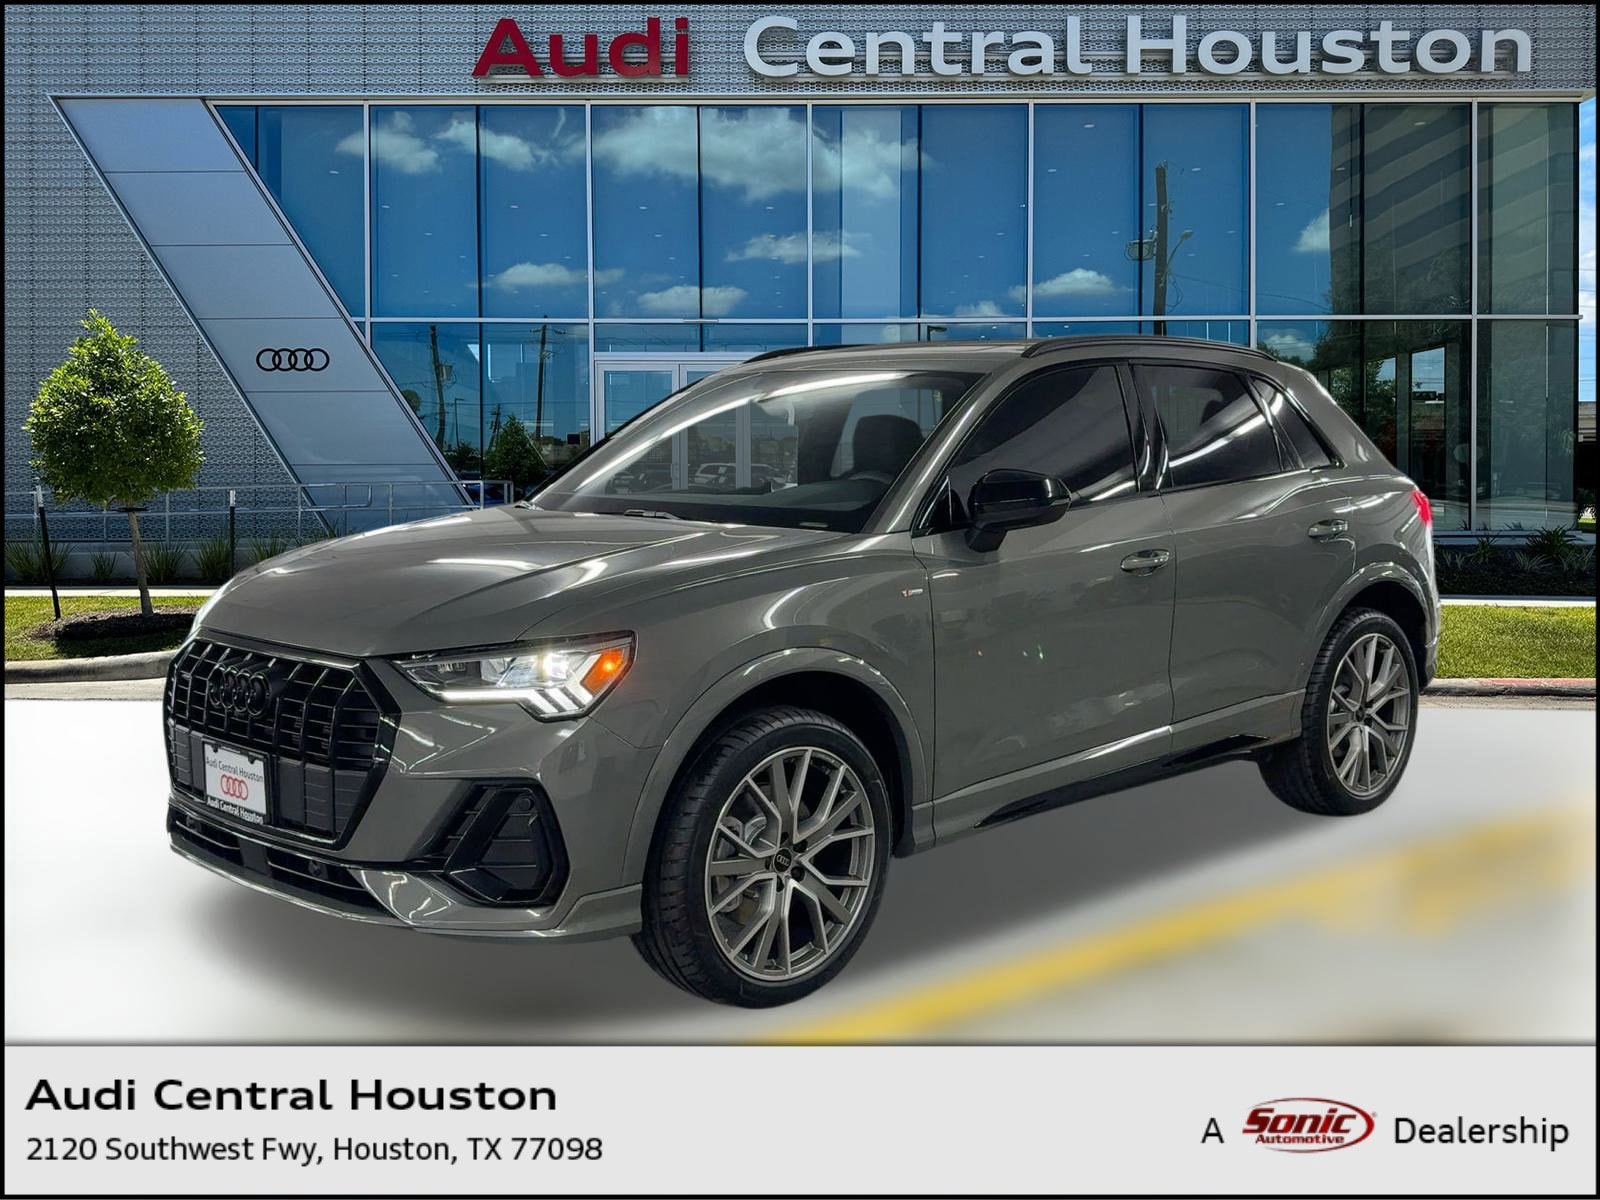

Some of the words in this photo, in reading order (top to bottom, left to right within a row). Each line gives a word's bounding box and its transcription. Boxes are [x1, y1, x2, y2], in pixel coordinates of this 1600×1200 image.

[471, 16, 689, 78] Audi
[743, 15, 1093, 77] Central
[1126, 14, 1532, 75] Houston
[206, 756, 218, 769] Audi
[219, 760, 239, 776] Central
[240, 767, 264, 782] Houston
[207, 796, 220, 809] Audi
[220, 800, 240, 816] Central
[240, 807, 265, 825] Houston
